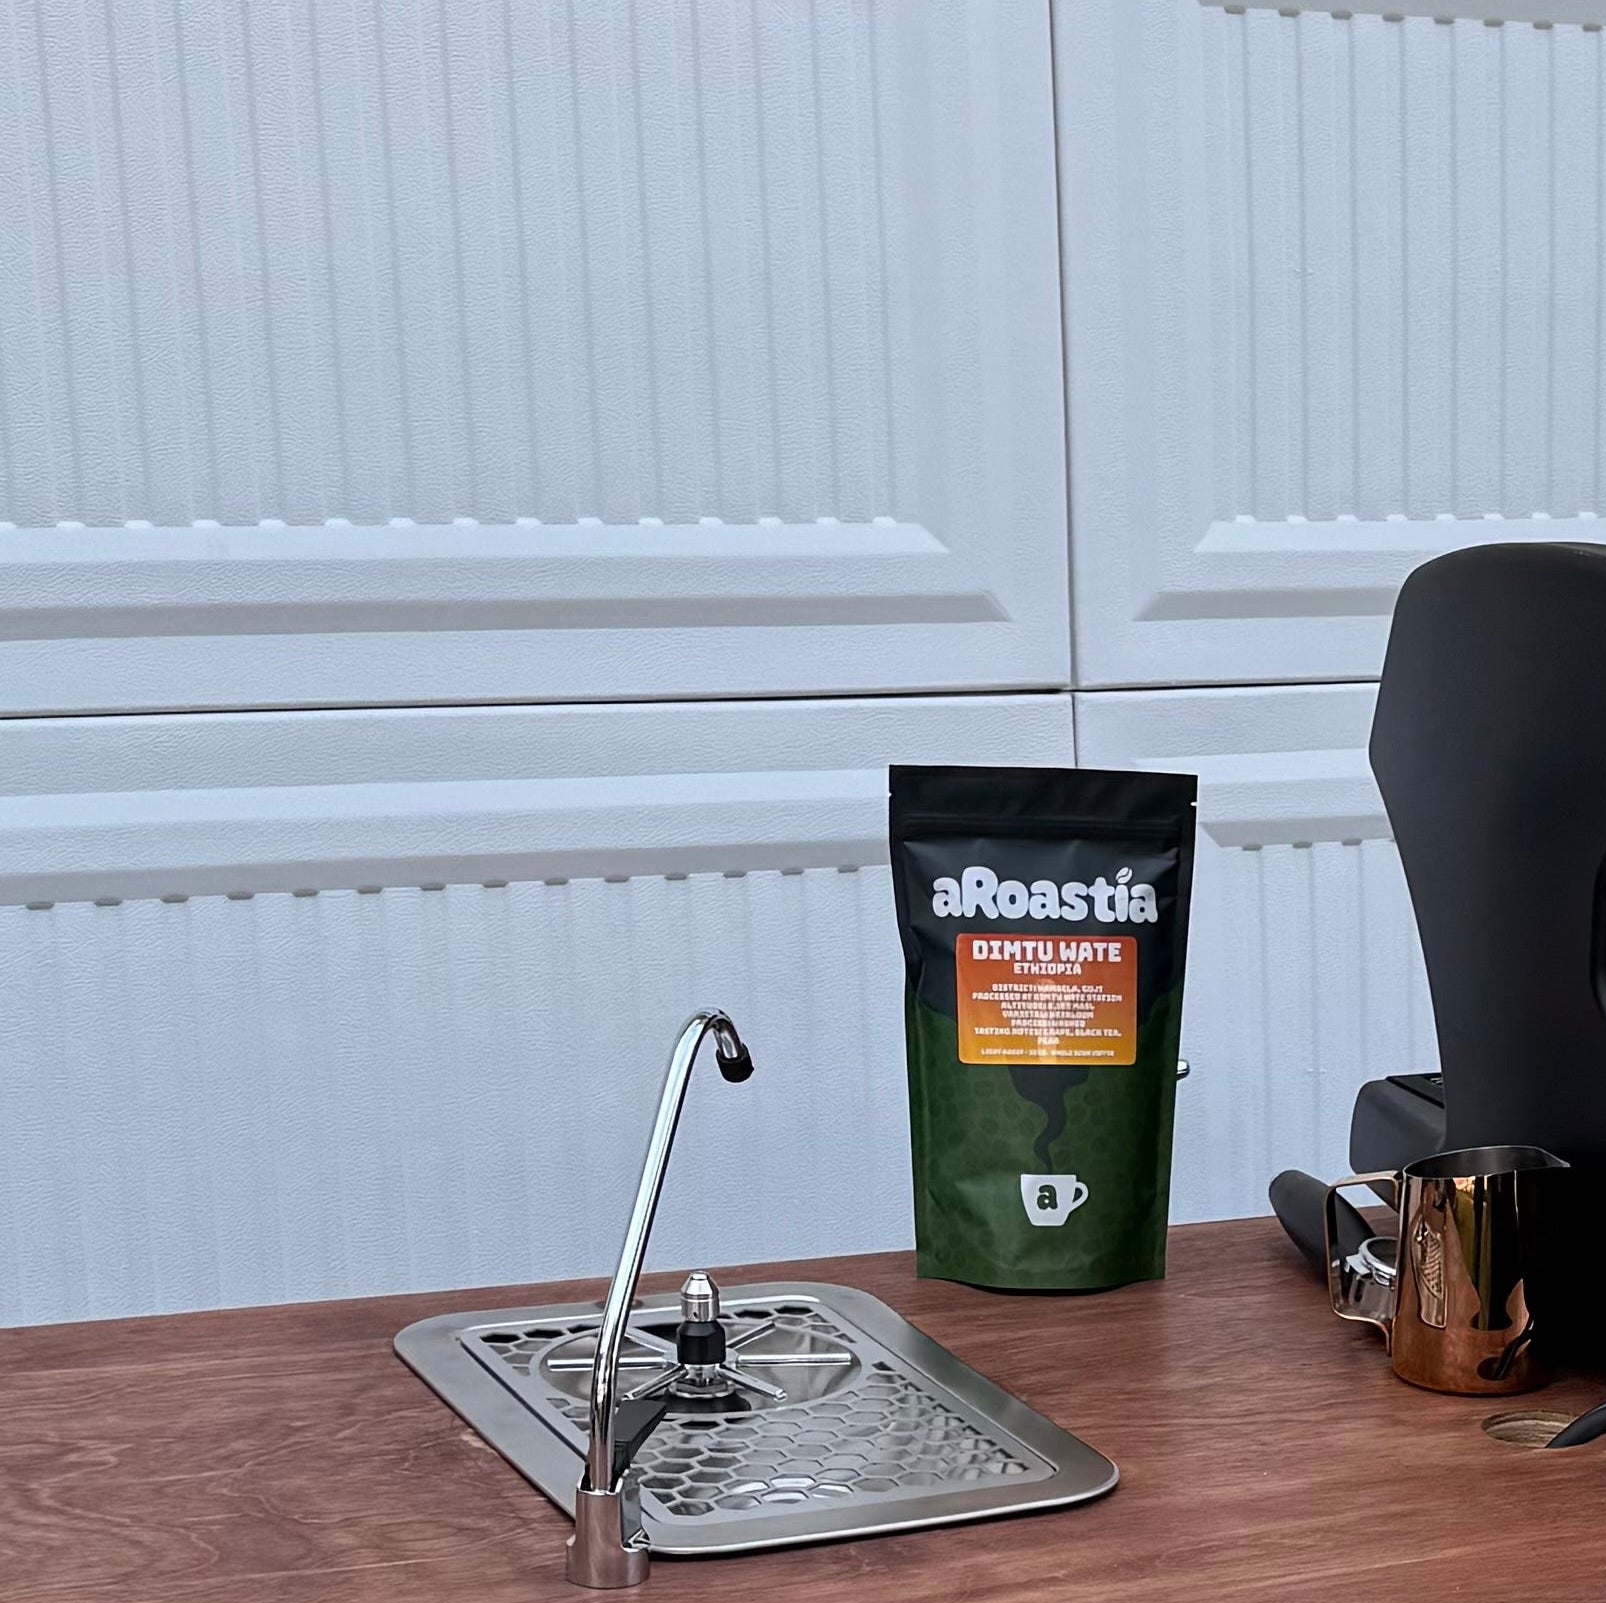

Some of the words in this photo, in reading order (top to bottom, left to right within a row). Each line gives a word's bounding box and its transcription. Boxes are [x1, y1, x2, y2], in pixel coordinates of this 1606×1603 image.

[972, 939, 1054, 962] DIMTU
[1059, 941, 1122, 963] WATE
[1013, 962, 1082, 975] ETHIOPIA
[1036, 1184, 1058, 1211] a
